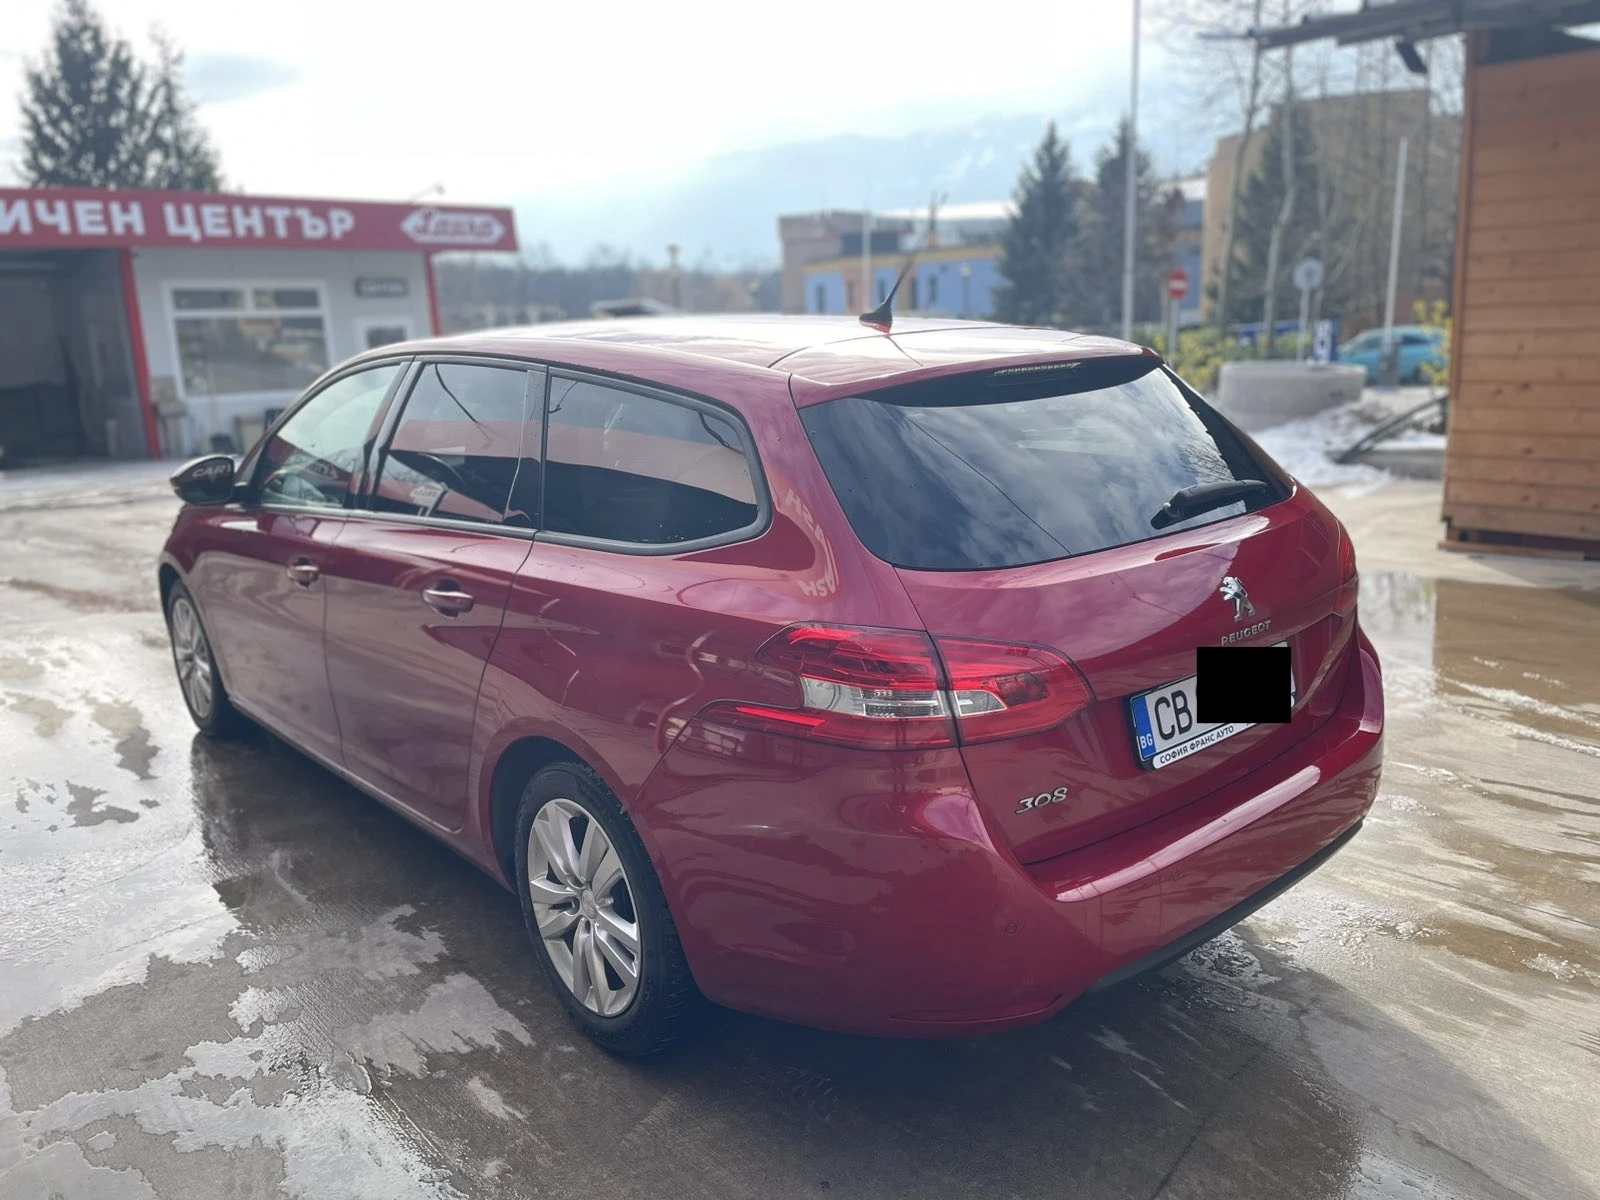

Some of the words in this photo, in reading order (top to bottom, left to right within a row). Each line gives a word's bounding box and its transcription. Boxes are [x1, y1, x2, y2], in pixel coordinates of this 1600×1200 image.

[0, 198, 146, 236] ИЧЕН
[163, 202, 356, 242] ЦЕНТЪР
[1221, 620, 1271, 646] PEUGEOT
[1140, 733, 1153, 749] BG
[1159, 746, 1189, 764] СОФИЯ
[1190, 734, 1216, 751] ФРАНС
[1216, 725, 1234, 740] АУТО
[1015, 787, 1068, 814] 308
